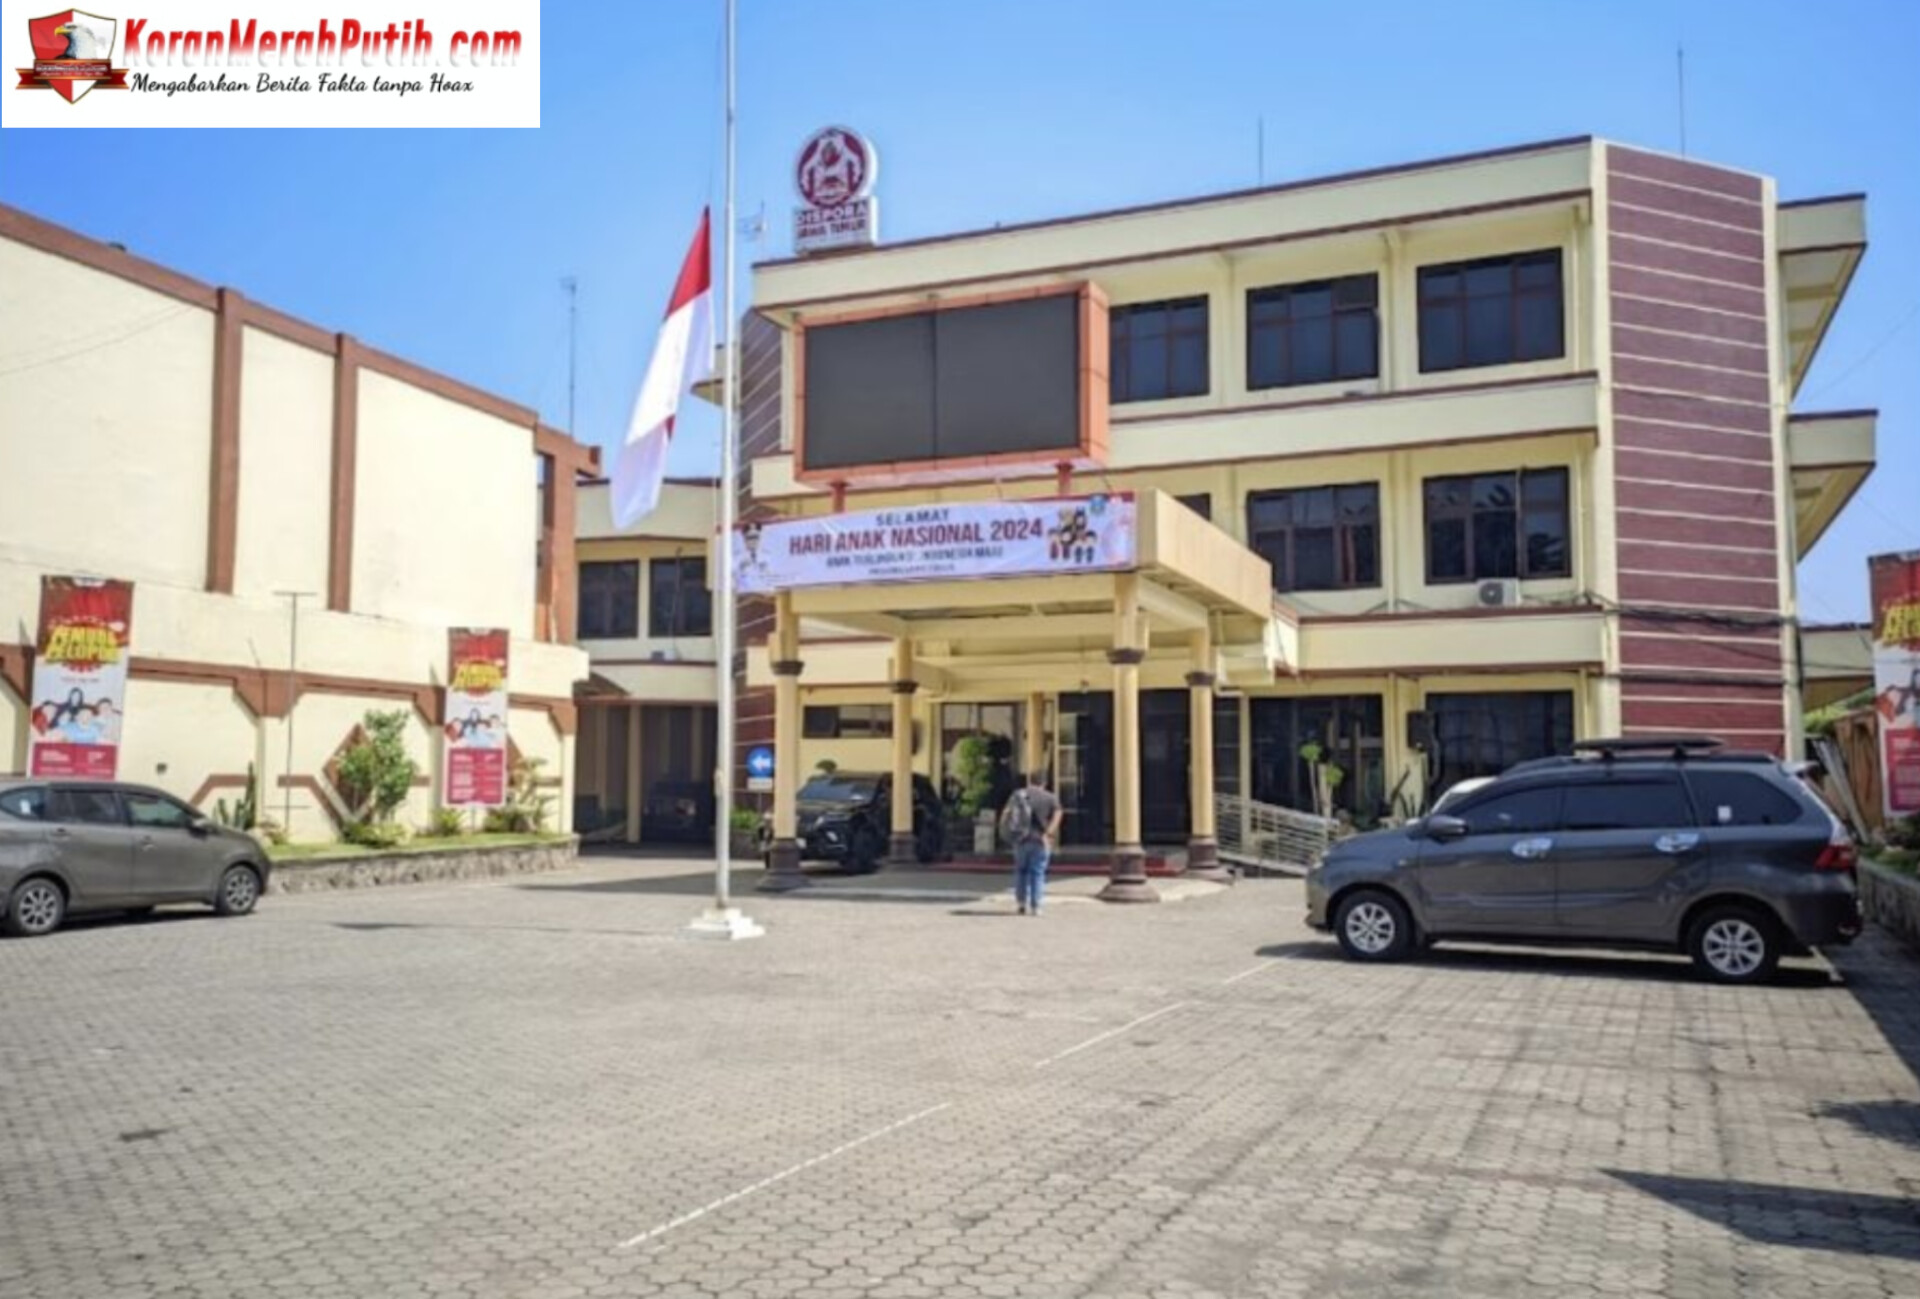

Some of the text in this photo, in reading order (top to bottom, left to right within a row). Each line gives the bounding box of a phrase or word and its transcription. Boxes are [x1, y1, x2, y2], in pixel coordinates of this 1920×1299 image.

[876, 508, 949, 526] SELAMAT
[789, 516, 1043, 555] HARI ANAK NASIONAL 2024
